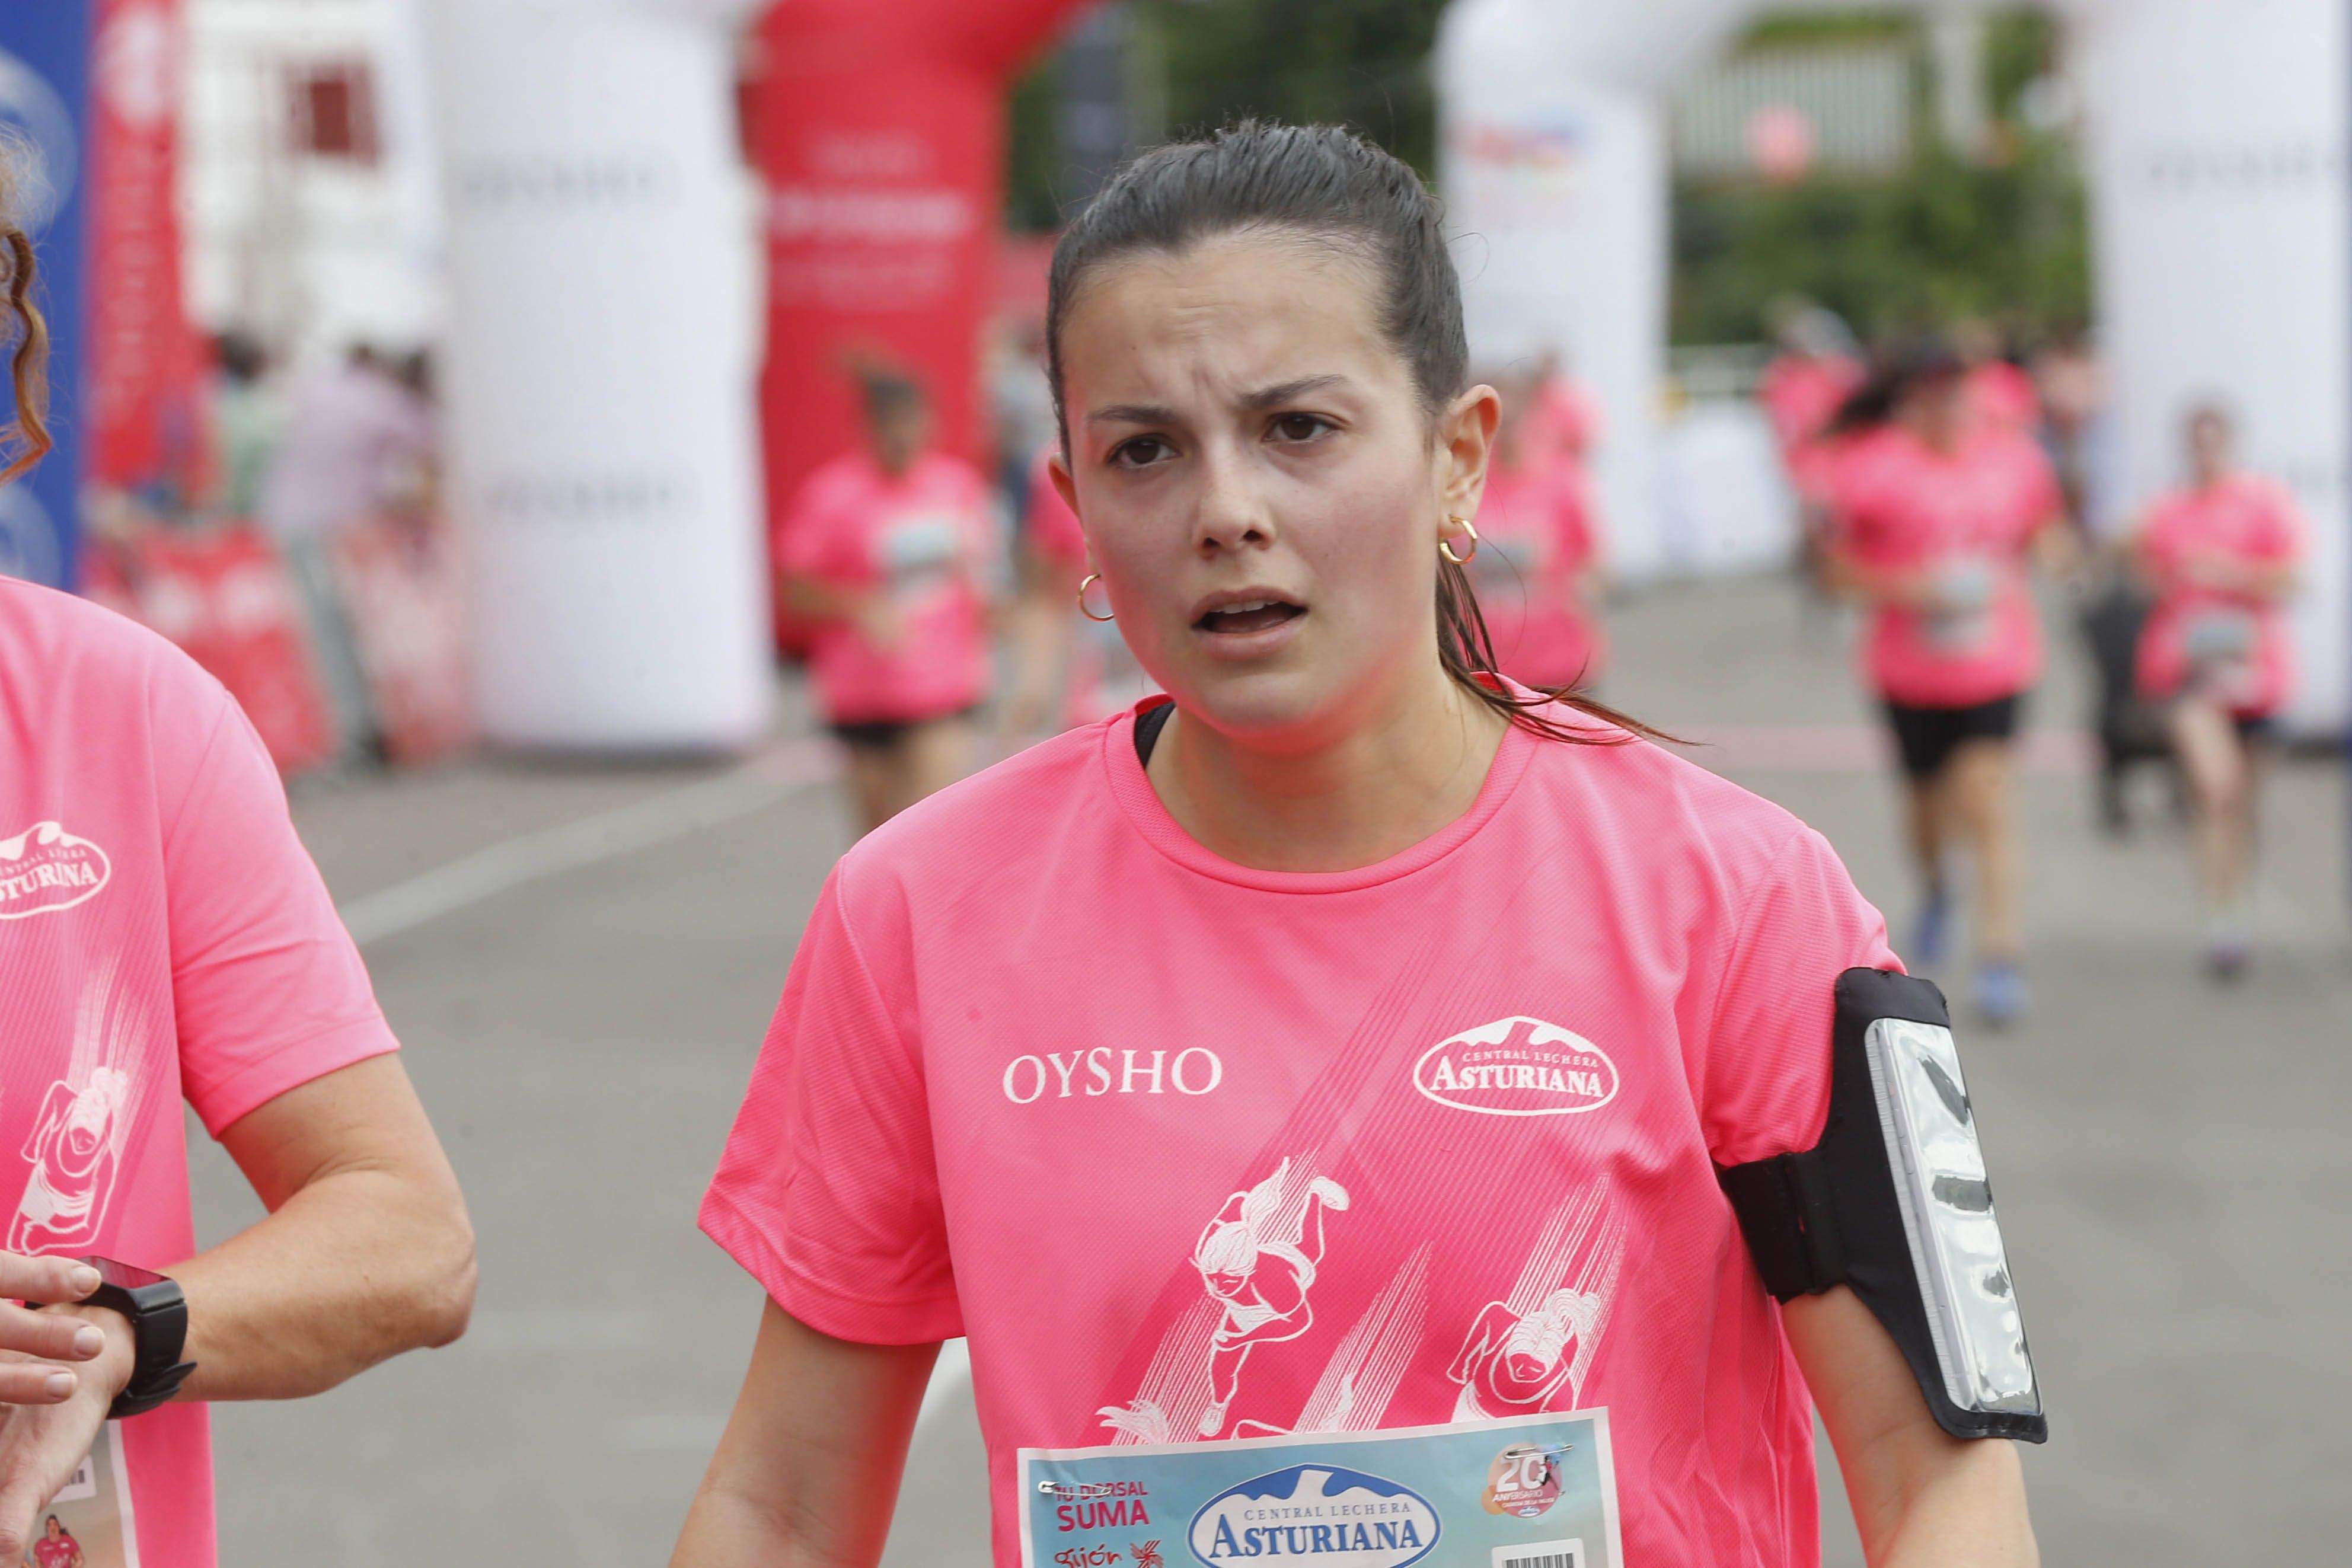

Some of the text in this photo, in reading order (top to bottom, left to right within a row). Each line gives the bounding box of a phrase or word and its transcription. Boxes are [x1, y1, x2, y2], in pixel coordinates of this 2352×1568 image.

[1003, 1046, 1223, 1104] OYSHO
[1462, 1050, 1599, 1068] CENTRAL LECHERA
[1429, 1055, 1604, 1097] ASTURIANA
[1079, 1481, 1148, 1500] DORSAL
[1057, 1499, 1150, 1532] SUMA
[1244, 1502, 1412, 1521] CENTRAL LECHERA
[1208, 1513, 1424, 1559] ASTURIANA
